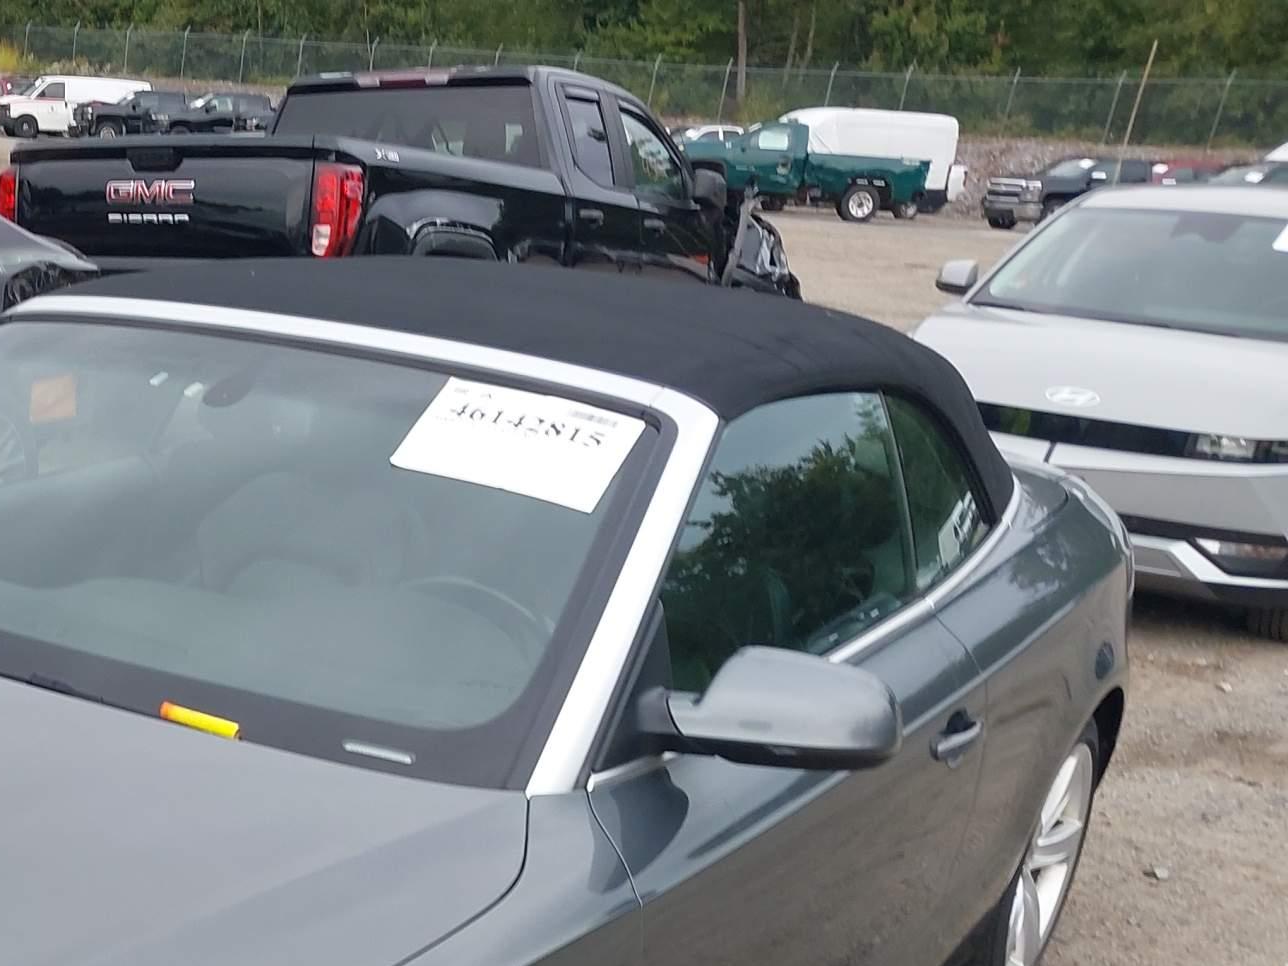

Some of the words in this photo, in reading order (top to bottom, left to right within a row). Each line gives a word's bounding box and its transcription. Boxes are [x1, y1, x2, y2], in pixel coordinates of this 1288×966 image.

[106, 179, 195, 206] GMC
[107, 212, 190, 225] SIERRA
[450, 402, 606, 448] 46142815
